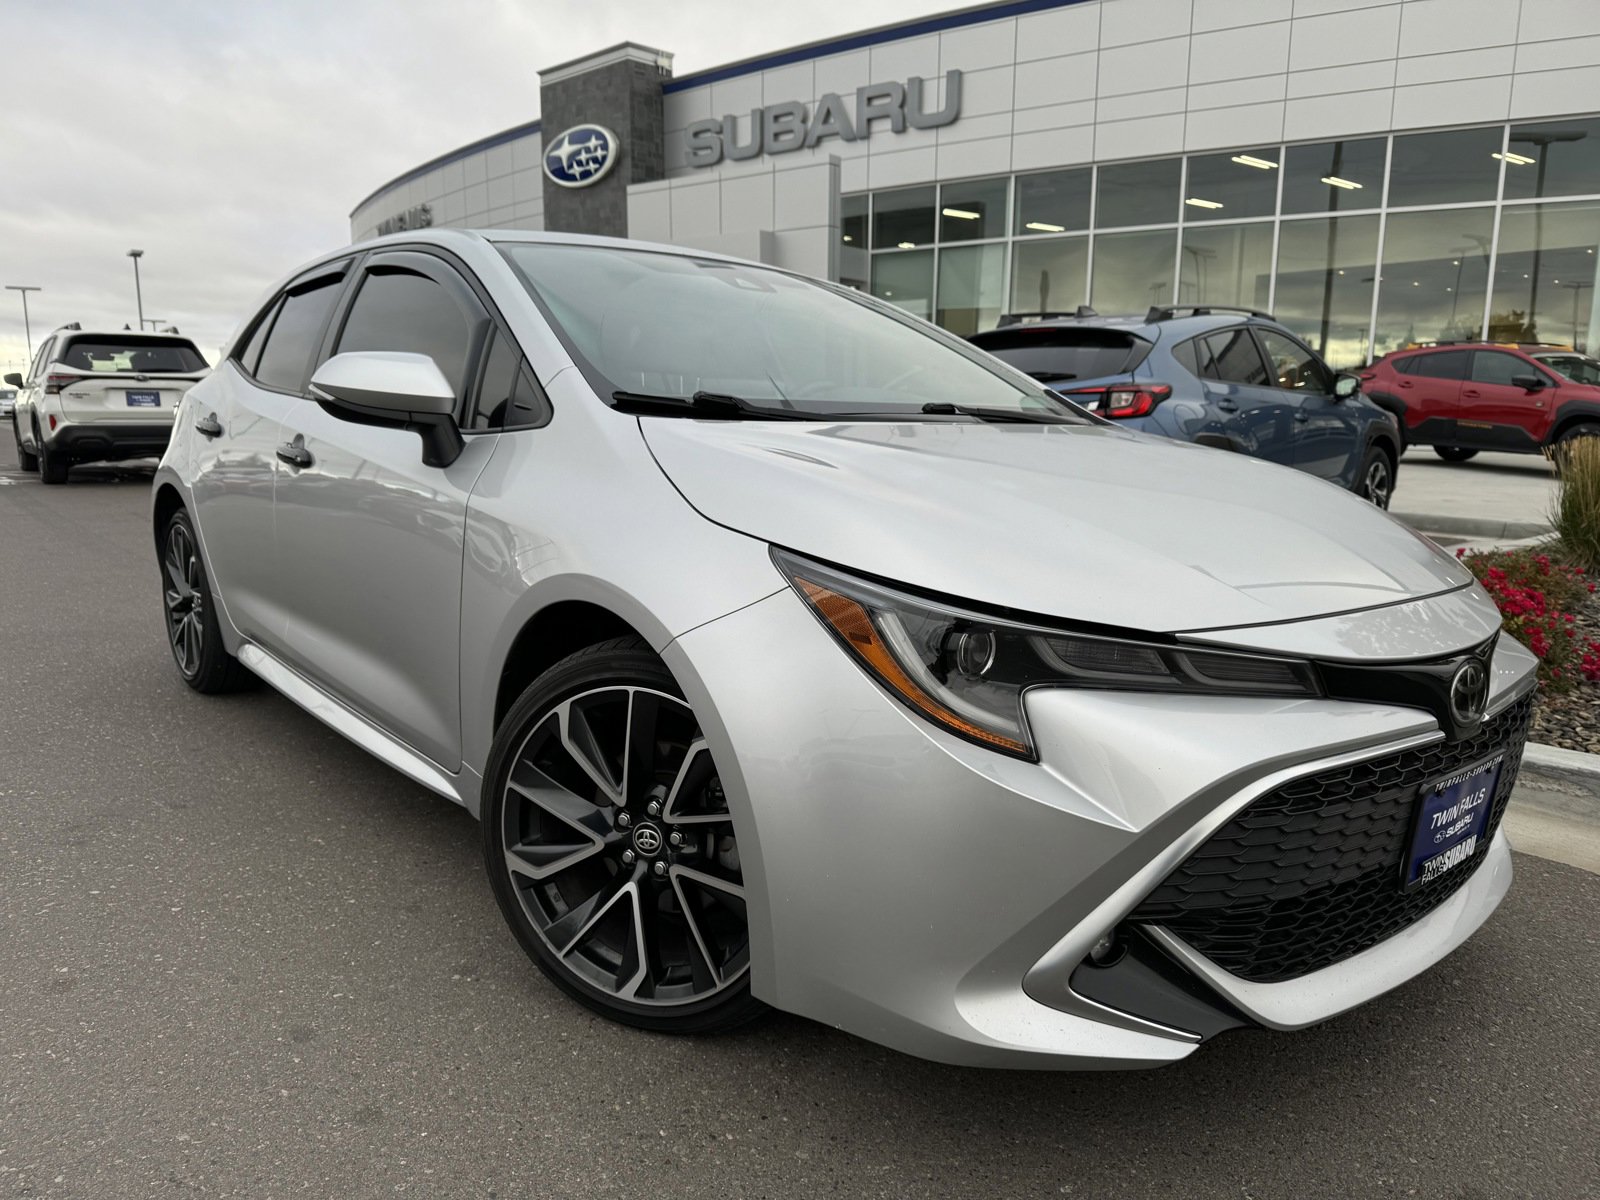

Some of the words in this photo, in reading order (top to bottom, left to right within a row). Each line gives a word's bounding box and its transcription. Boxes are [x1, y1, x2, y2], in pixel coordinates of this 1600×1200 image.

[684, 69, 963, 168] SUBARU
[1430, 803, 1460, 830] TWIN
[1458, 787, 1486, 816] FALLS
[1445, 811, 1475, 838] SUBARU
[1424, 852, 1447, 874] TWIN
[1442, 834, 1478, 873] SUBARU
[1421, 864, 1445, 886] FALLS
